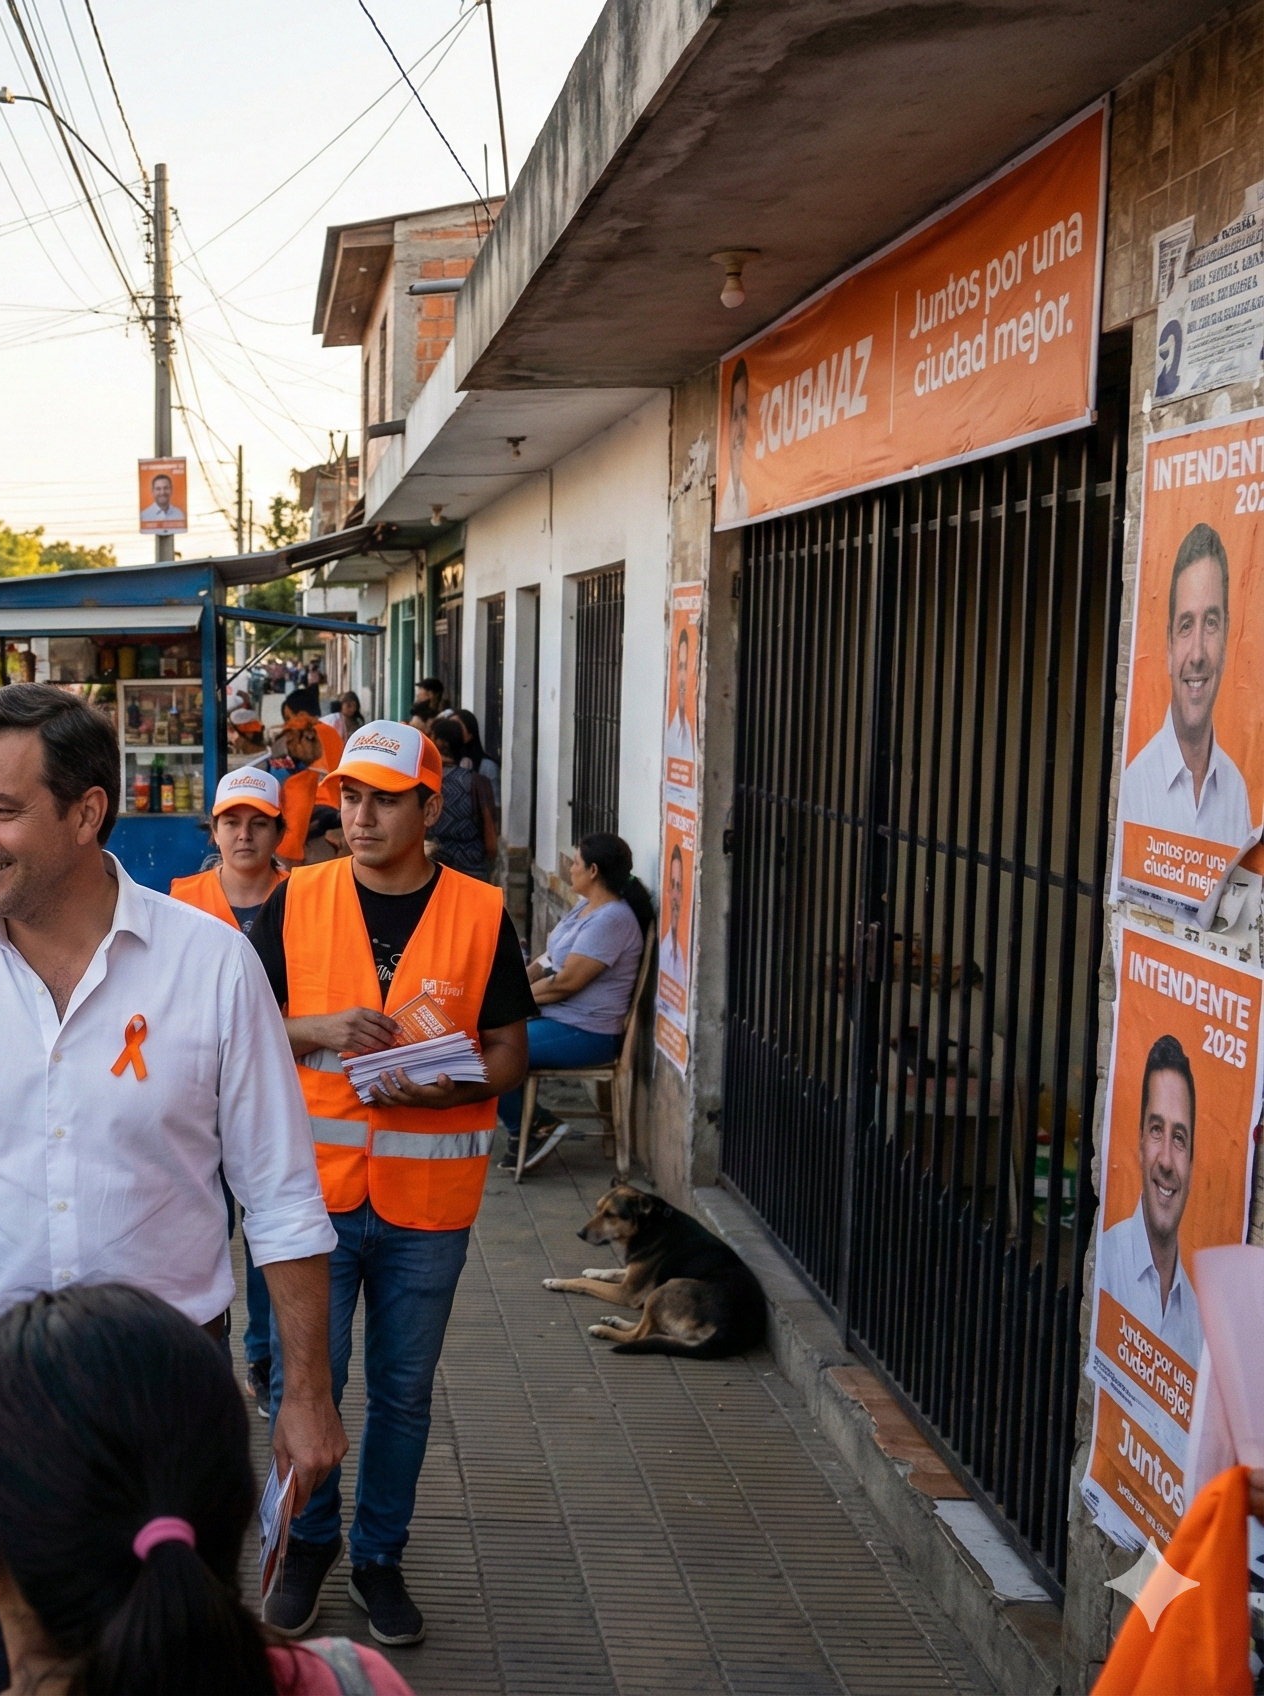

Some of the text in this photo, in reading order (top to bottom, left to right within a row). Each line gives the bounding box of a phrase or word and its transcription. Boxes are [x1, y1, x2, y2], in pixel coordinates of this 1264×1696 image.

[909, 269, 981, 340] Juntos
[986, 241, 1028, 314] por
[1032, 211, 1083, 275] una
[914, 289, 1073, 397] ciudad mejor.
[1206, 853, 1226, 872] una
[1129, 951, 1251, 1031] INTENDENTE
[1202, 1024, 1247, 1069] 2025
[1173, 1366, 1193, 1396] una
[1118, 1418, 1184, 1517] Juntos
